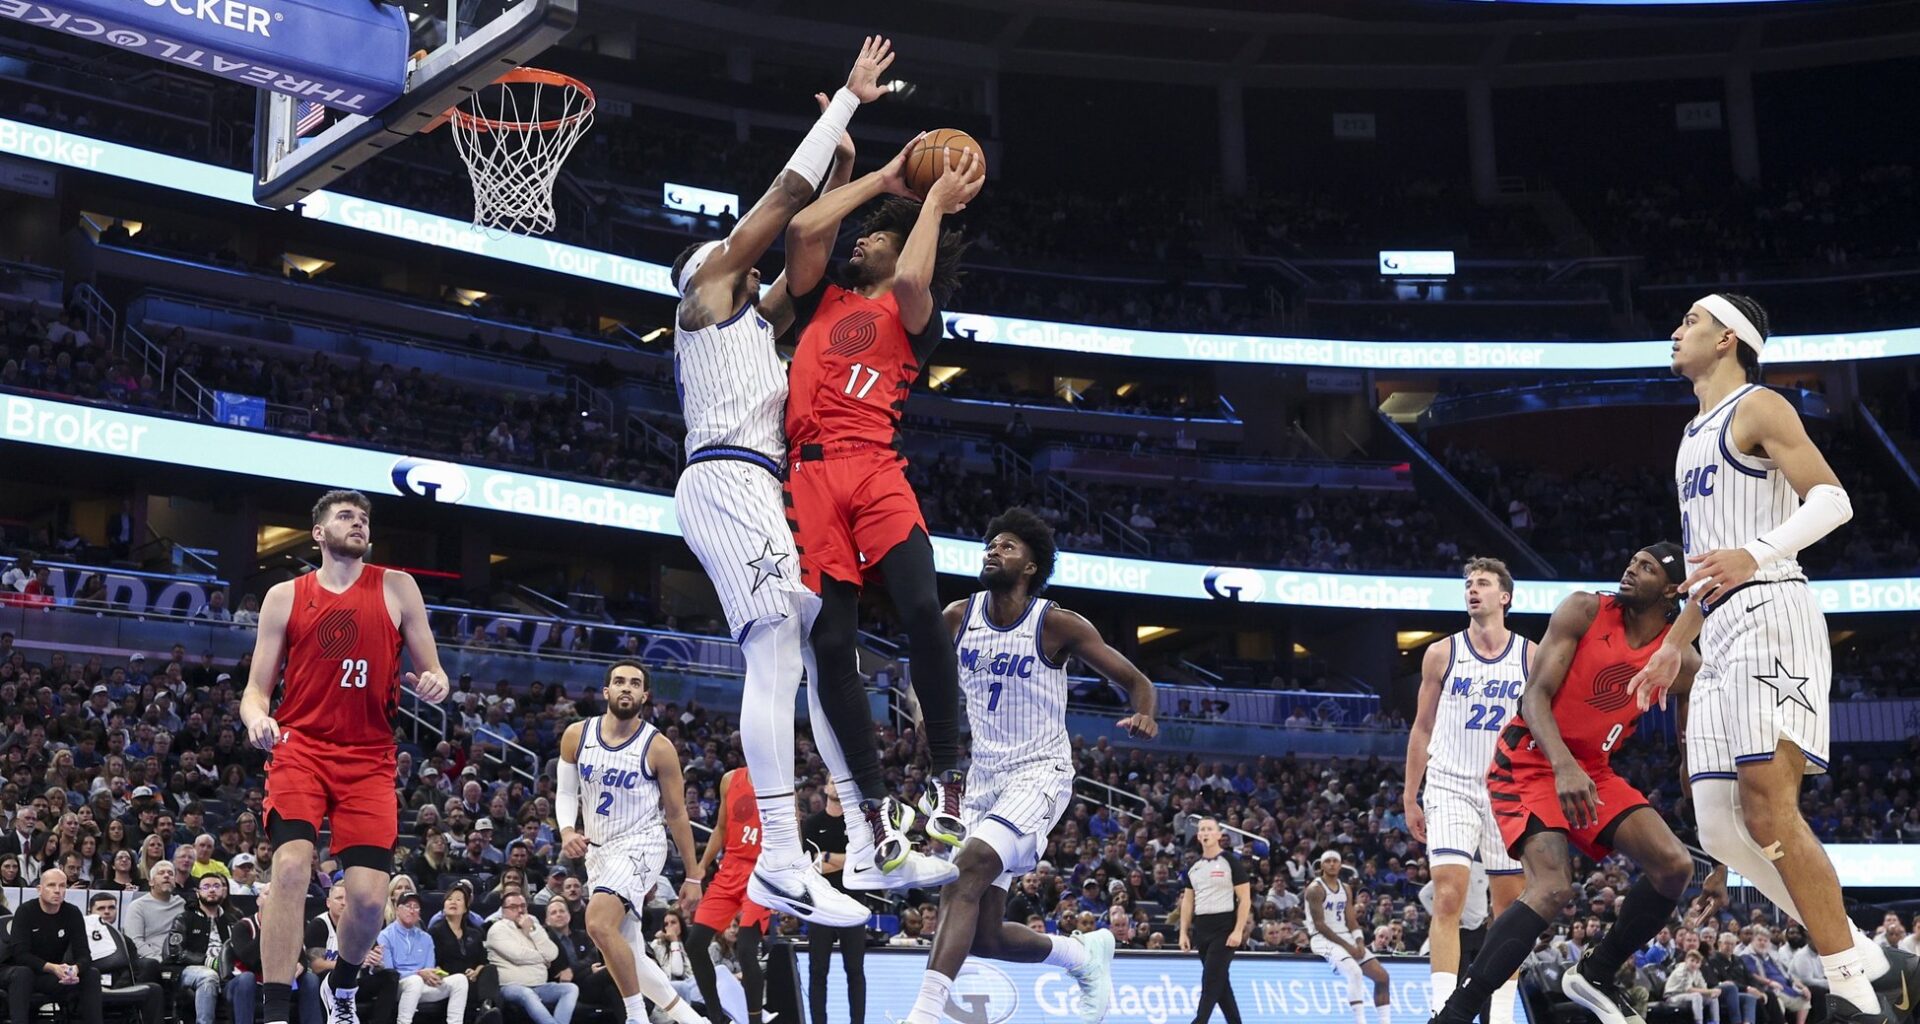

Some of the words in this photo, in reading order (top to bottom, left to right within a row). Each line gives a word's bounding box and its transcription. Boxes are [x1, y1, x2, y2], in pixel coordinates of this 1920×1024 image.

[0, 121, 104, 168] Broker
[340, 199, 488, 256] Gallagher
[545, 241, 601, 278] Your
[1006, 320, 1135, 354] Gallagher
[1182, 335, 1238, 358] Your
[1244, 338, 1332, 363] Trusted
[1340, 342, 1457, 366] Insurance
[1463, 343, 1546, 366] Broker
[1763, 337, 1887, 361] allagher
[844, 363, 880, 399] 17
[6, 398, 149, 454] Broker
[482, 473, 664, 531] Gallagher
[1061, 554, 1150, 590] Broker
[1275, 574, 1433, 609] Gallagher
[1512, 586, 1559, 611] our
[340, 659, 367, 688] 23
[987, 682, 1002, 711] 1
[1465, 704, 1506, 731] 22
[1602, 723, 1624, 752] 9
[596, 792, 614, 816] 2
[741, 826, 757, 845] 24
[1336, 912, 1342, 922] 5
[91, 930, 103, 941] G
